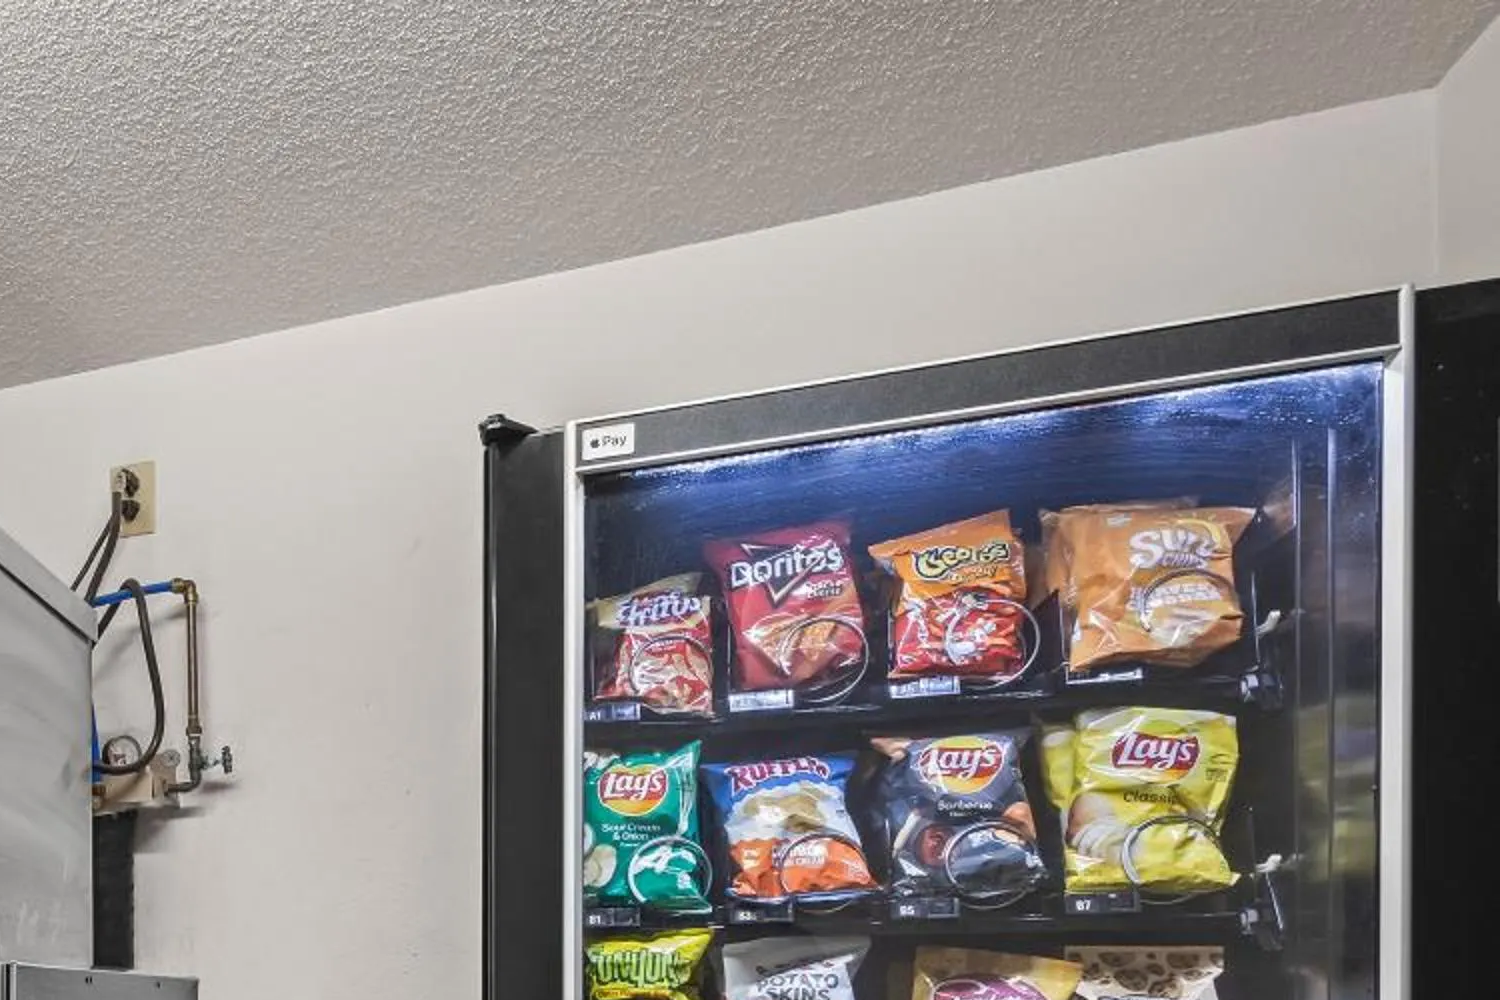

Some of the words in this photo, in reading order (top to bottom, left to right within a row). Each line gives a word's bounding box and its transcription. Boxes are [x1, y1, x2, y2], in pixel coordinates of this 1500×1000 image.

[602, 435, 627, 448] Pay
[731, 543, 844, 589] Doritos
[756, 973, 839, 992] POTATO
